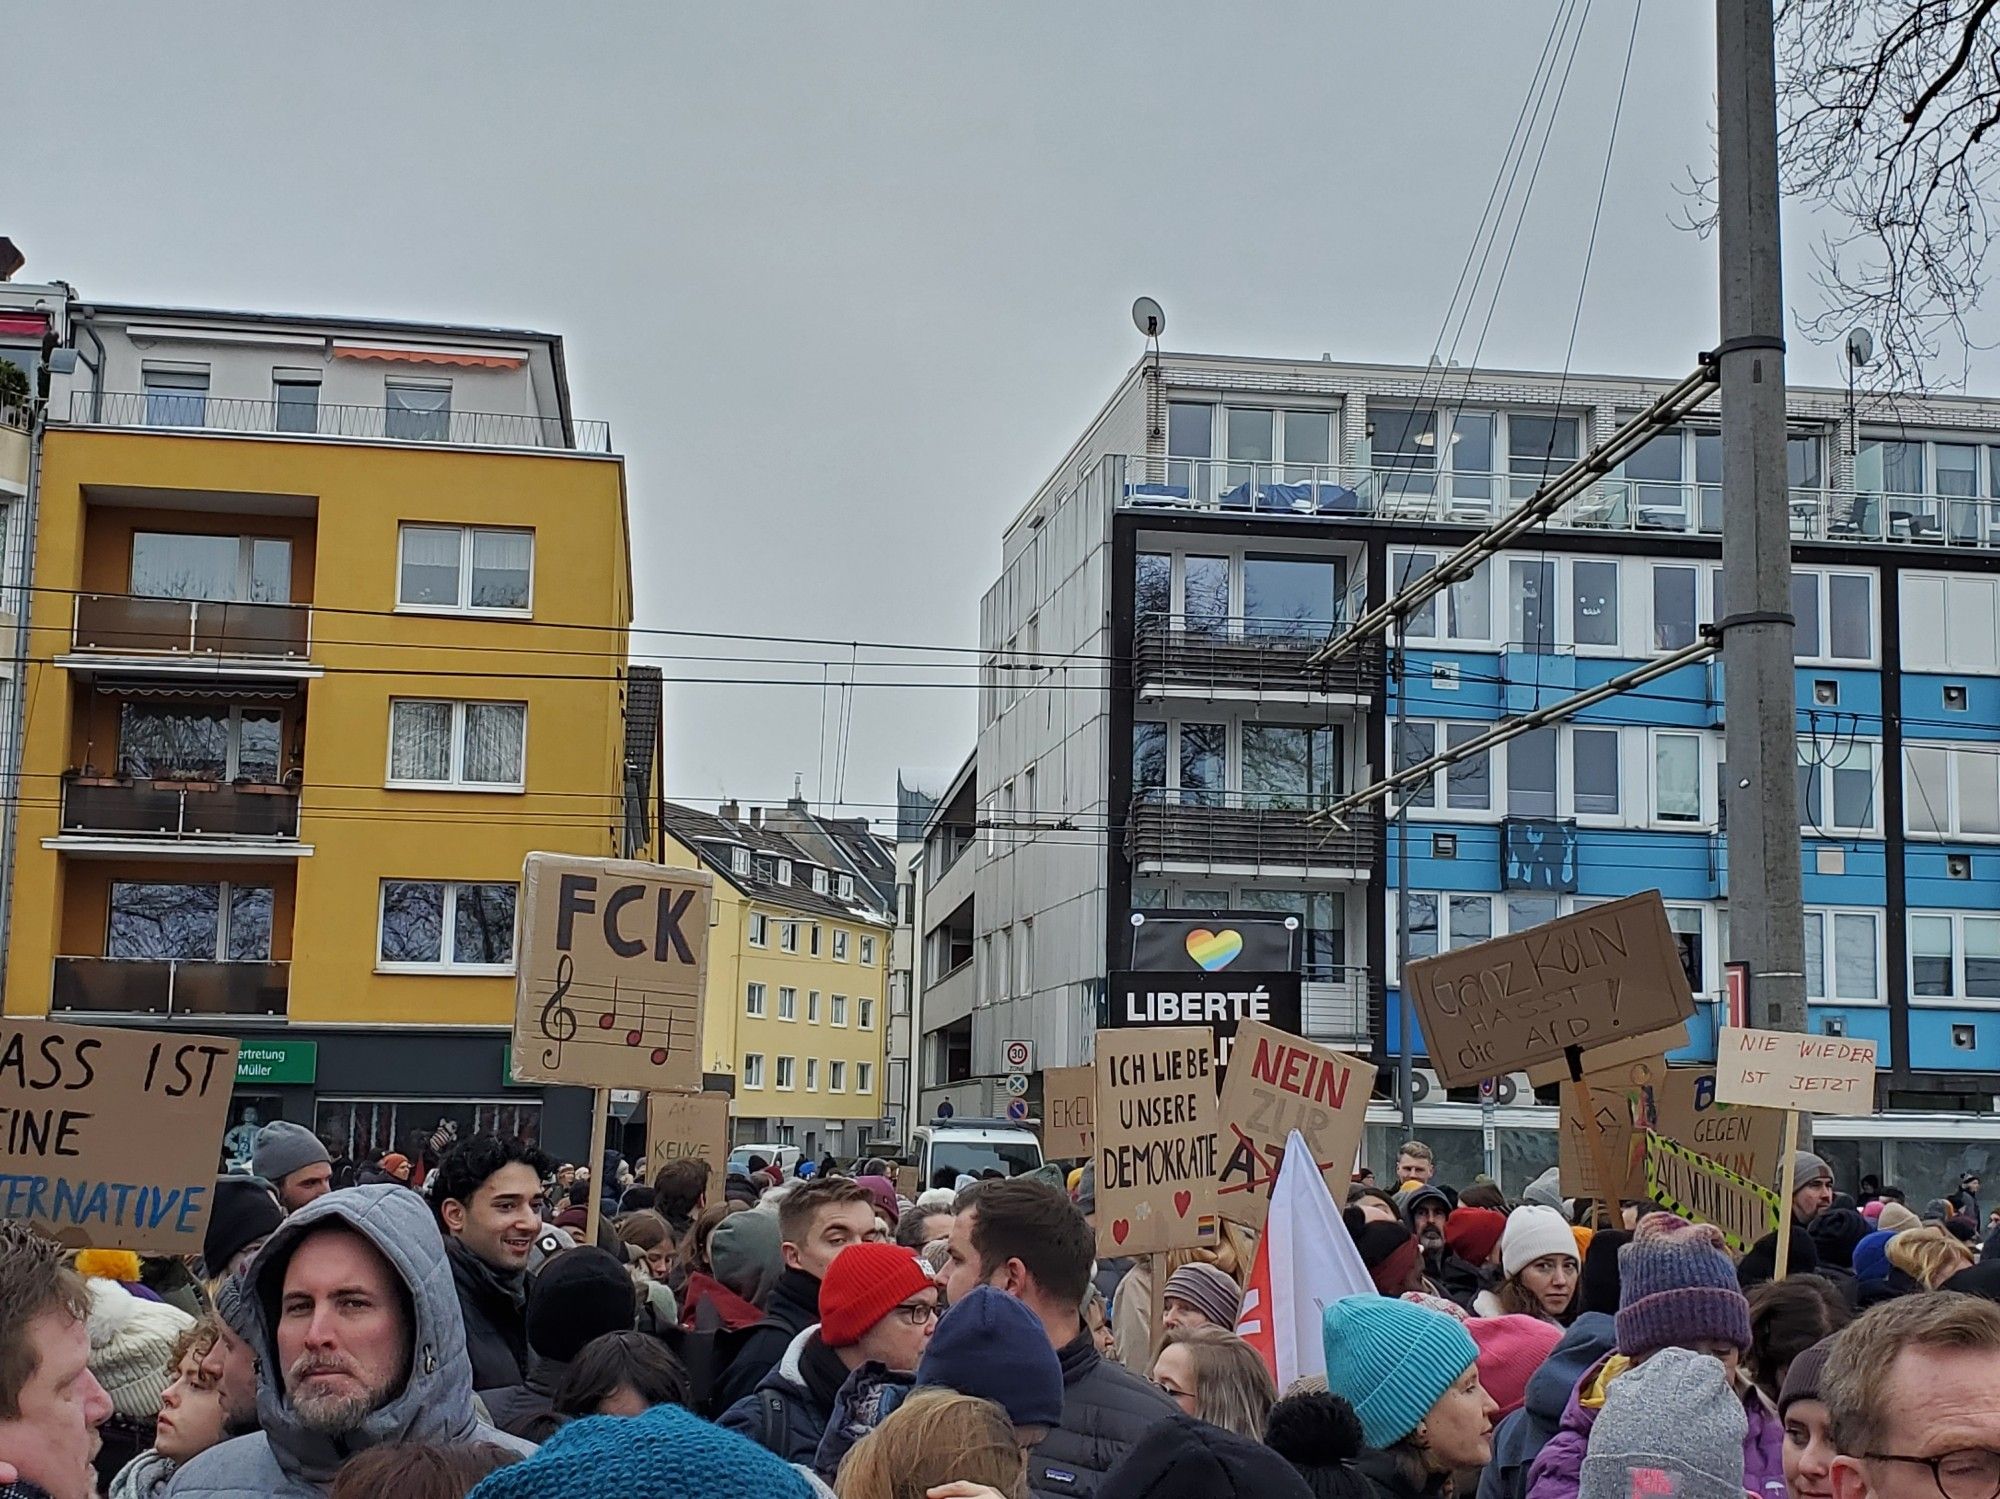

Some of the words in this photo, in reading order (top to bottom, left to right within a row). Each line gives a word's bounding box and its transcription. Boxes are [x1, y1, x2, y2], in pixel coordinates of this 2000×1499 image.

[556, 874, 697, 965] FCK
[1126, 984, 1271, 1021] LIBERTÉ
[0, 1032, 102, 1090] ASS
[144, 1042, 230, 1097] IST
[1011, 1048, 1024, 1060] 30
[1109, 1053, 1145, 1087] ICH
[1152, 1047, 1209, 1083] LIEBE
[1740, 1034, 1780, 1052] NIE
[1799, 1040, 1875, 1064] WIEDER
[238, 1063, 272, 1076] Müller
[1251, 1038, 1351, 1110] NEIN
[1740, 1069, 1770, 1084] IST
[1789, 1075, 1860, 1093] JETZT
[1119, 1093, 1197, 1130] UNSERE
[1246, 1088, 1330, 1154] ZUR
[1694, 1116, 1752, 1143] GEGEN
[655, 1140, 711, 1160] KEINE
[1103, 1132, 1218, 1189] DEMOKRATIE
